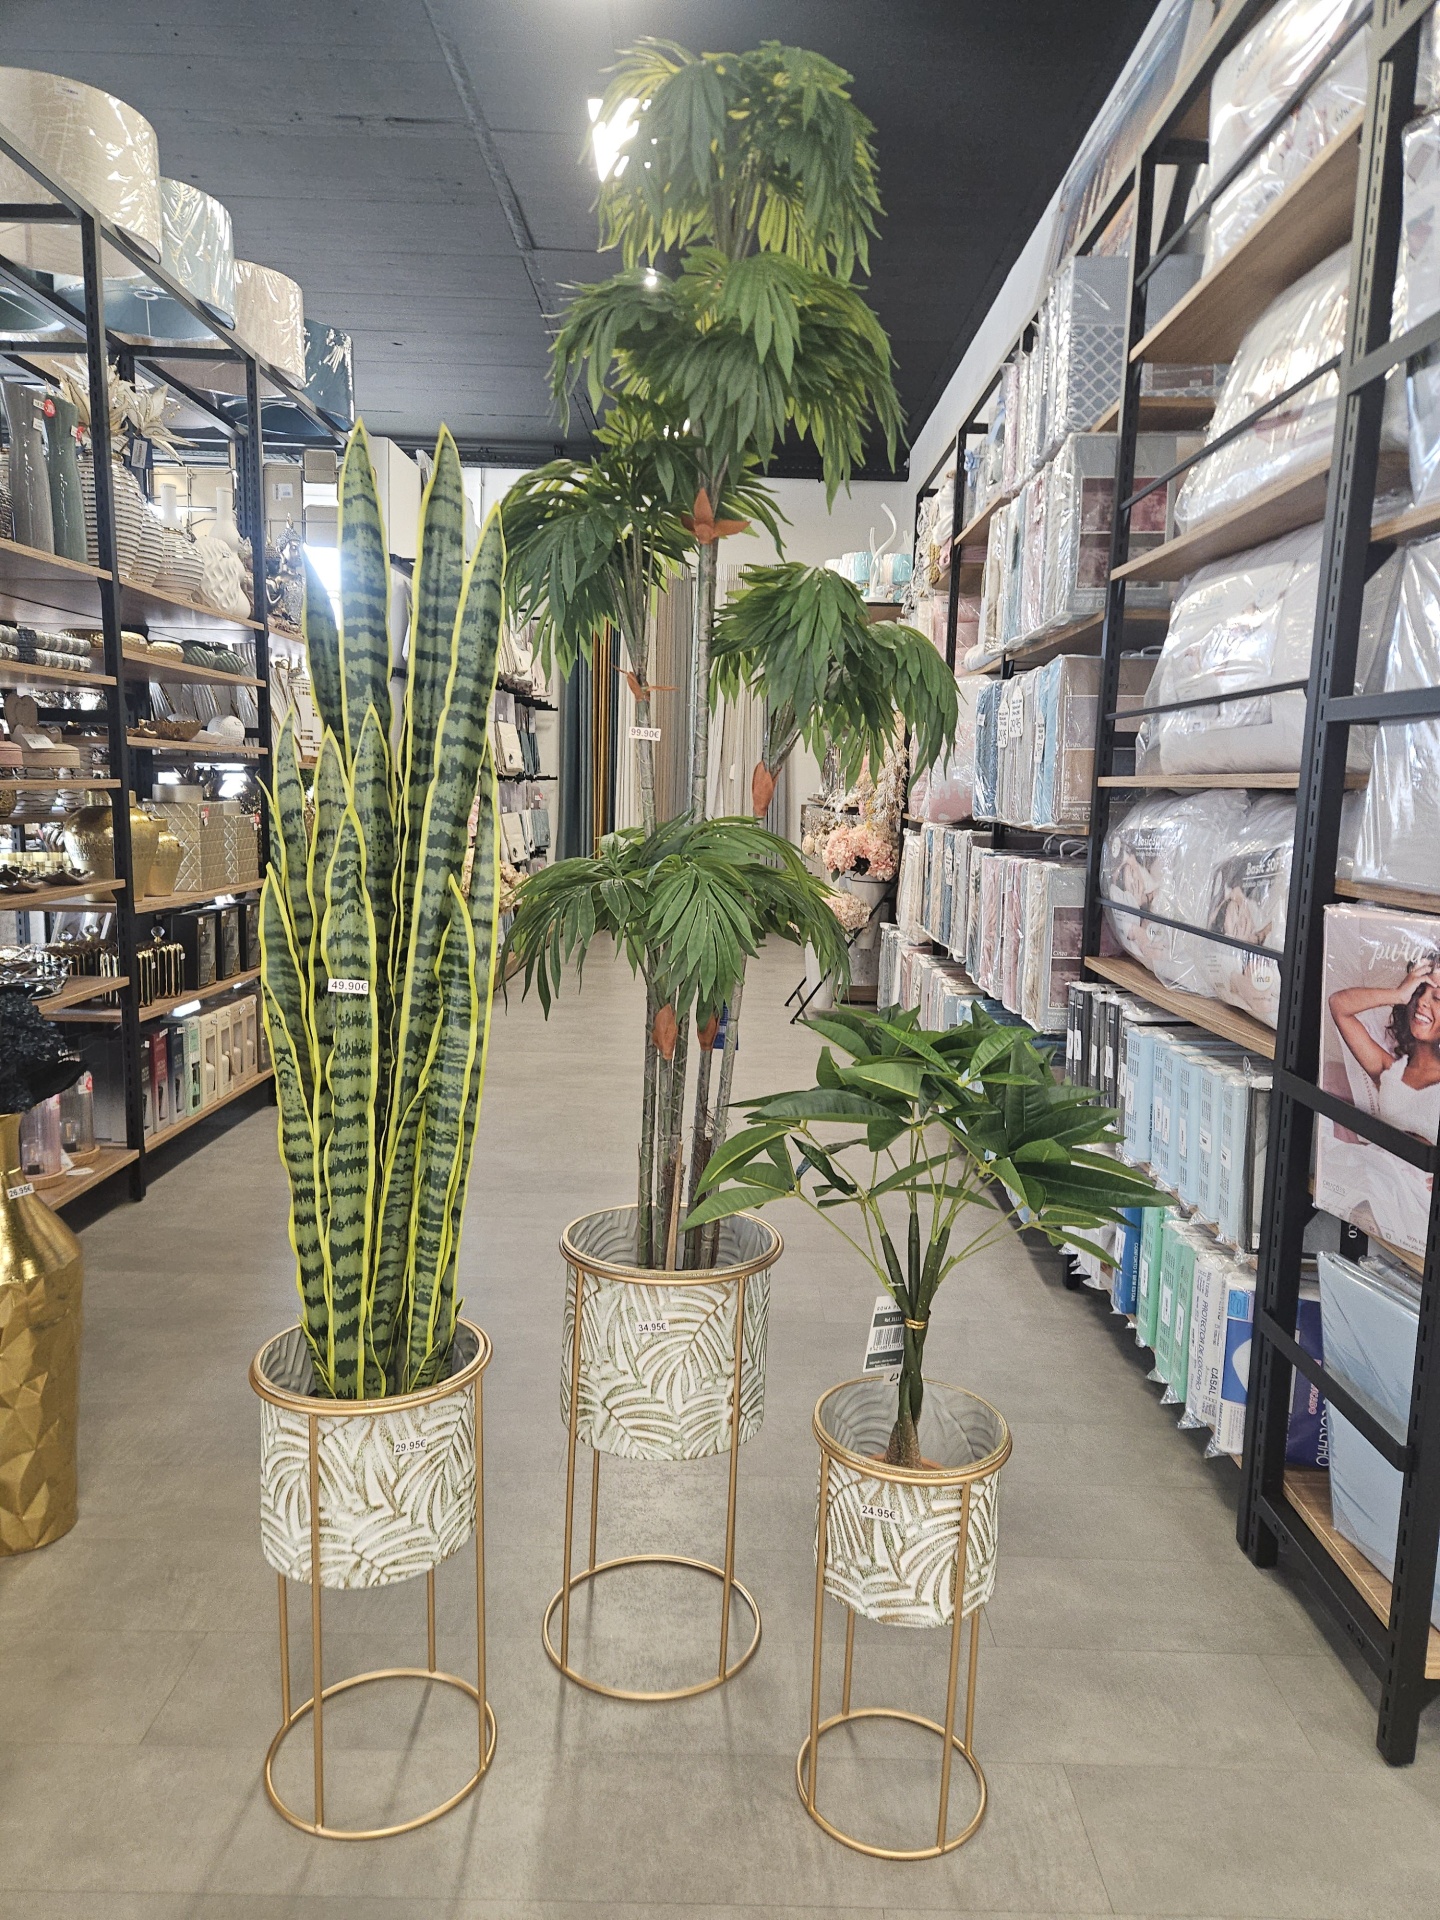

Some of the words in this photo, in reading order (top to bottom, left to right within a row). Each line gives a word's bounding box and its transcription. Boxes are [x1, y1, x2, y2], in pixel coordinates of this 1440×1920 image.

[631, 728, 660, 738] 99.90€
[331, 980, 368, 992] 49.90€
[9, 1184, 33, 1197] 26.95€
[638, 1322, 667, 1332] 34.95€
[1208, 1367, 1219, 1396] CASAL
[395, 1438, 427, 1453] 29.95€
[861, 1504, 896, 1520] 24.95€
